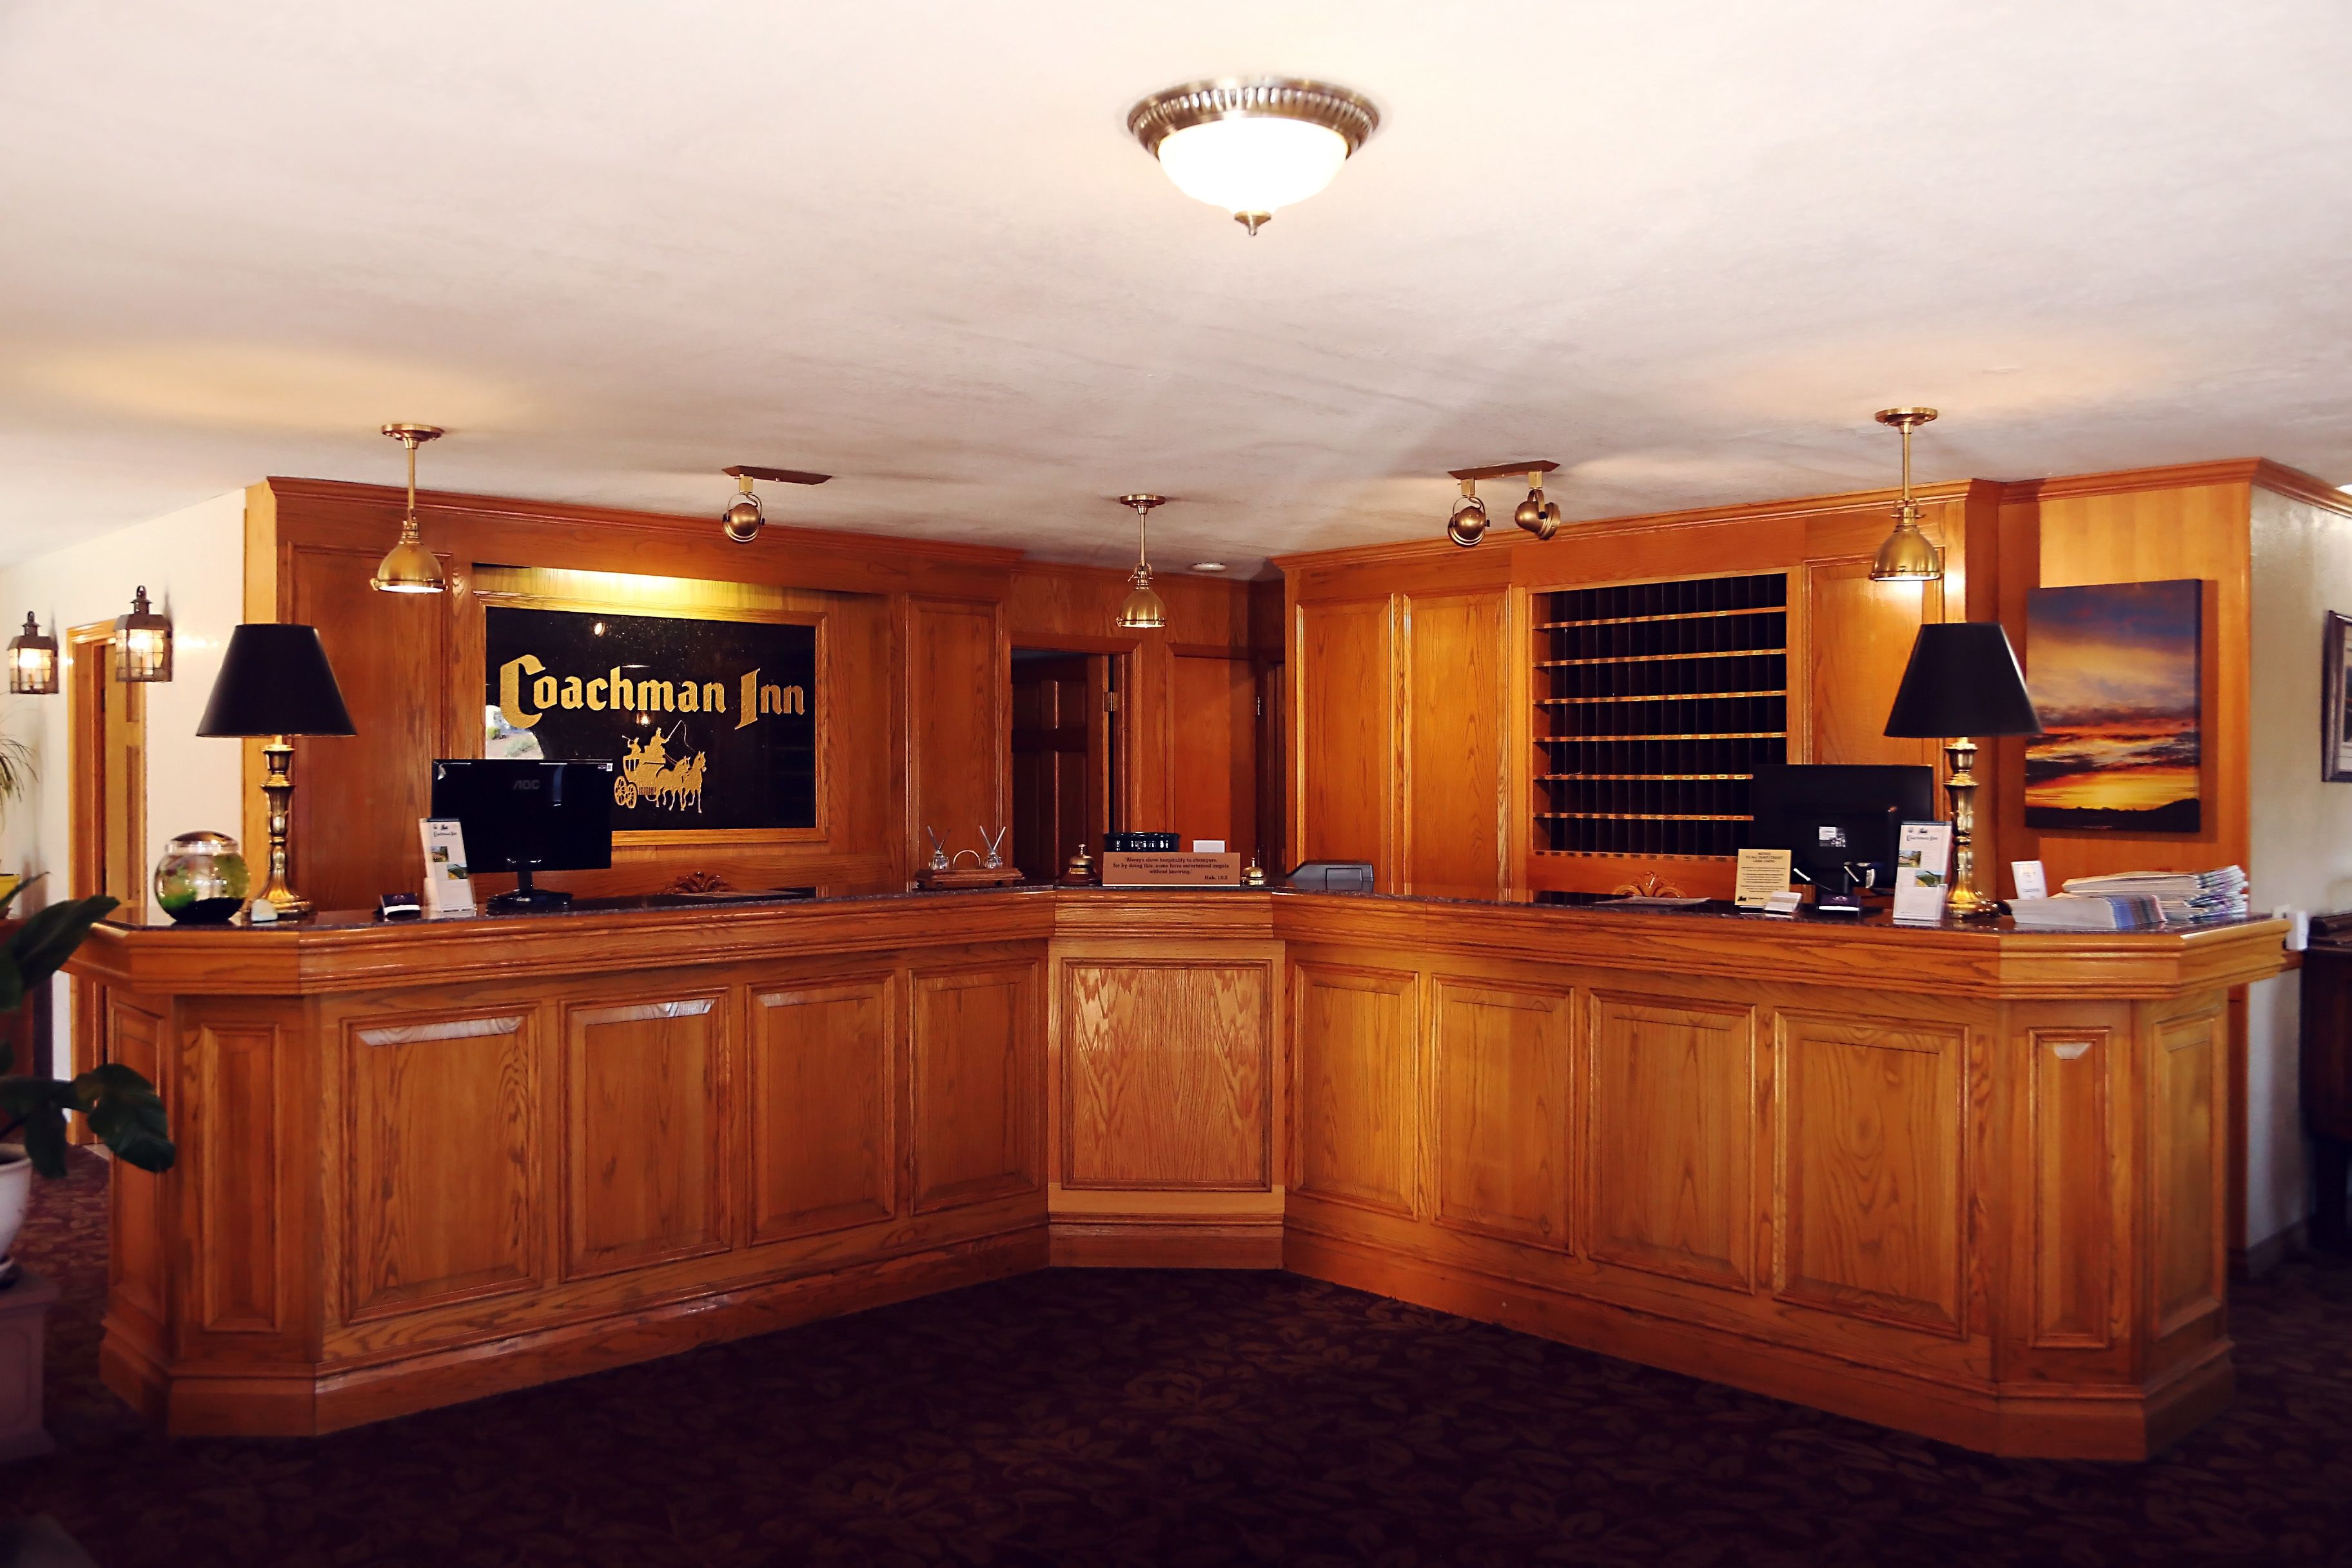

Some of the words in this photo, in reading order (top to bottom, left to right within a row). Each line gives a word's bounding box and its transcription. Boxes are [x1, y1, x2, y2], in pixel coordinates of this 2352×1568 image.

[500, 654, 727, 729] Coachman
[734, 667, 805, 730] Inn
[513, 779, 540, 790] AOC
